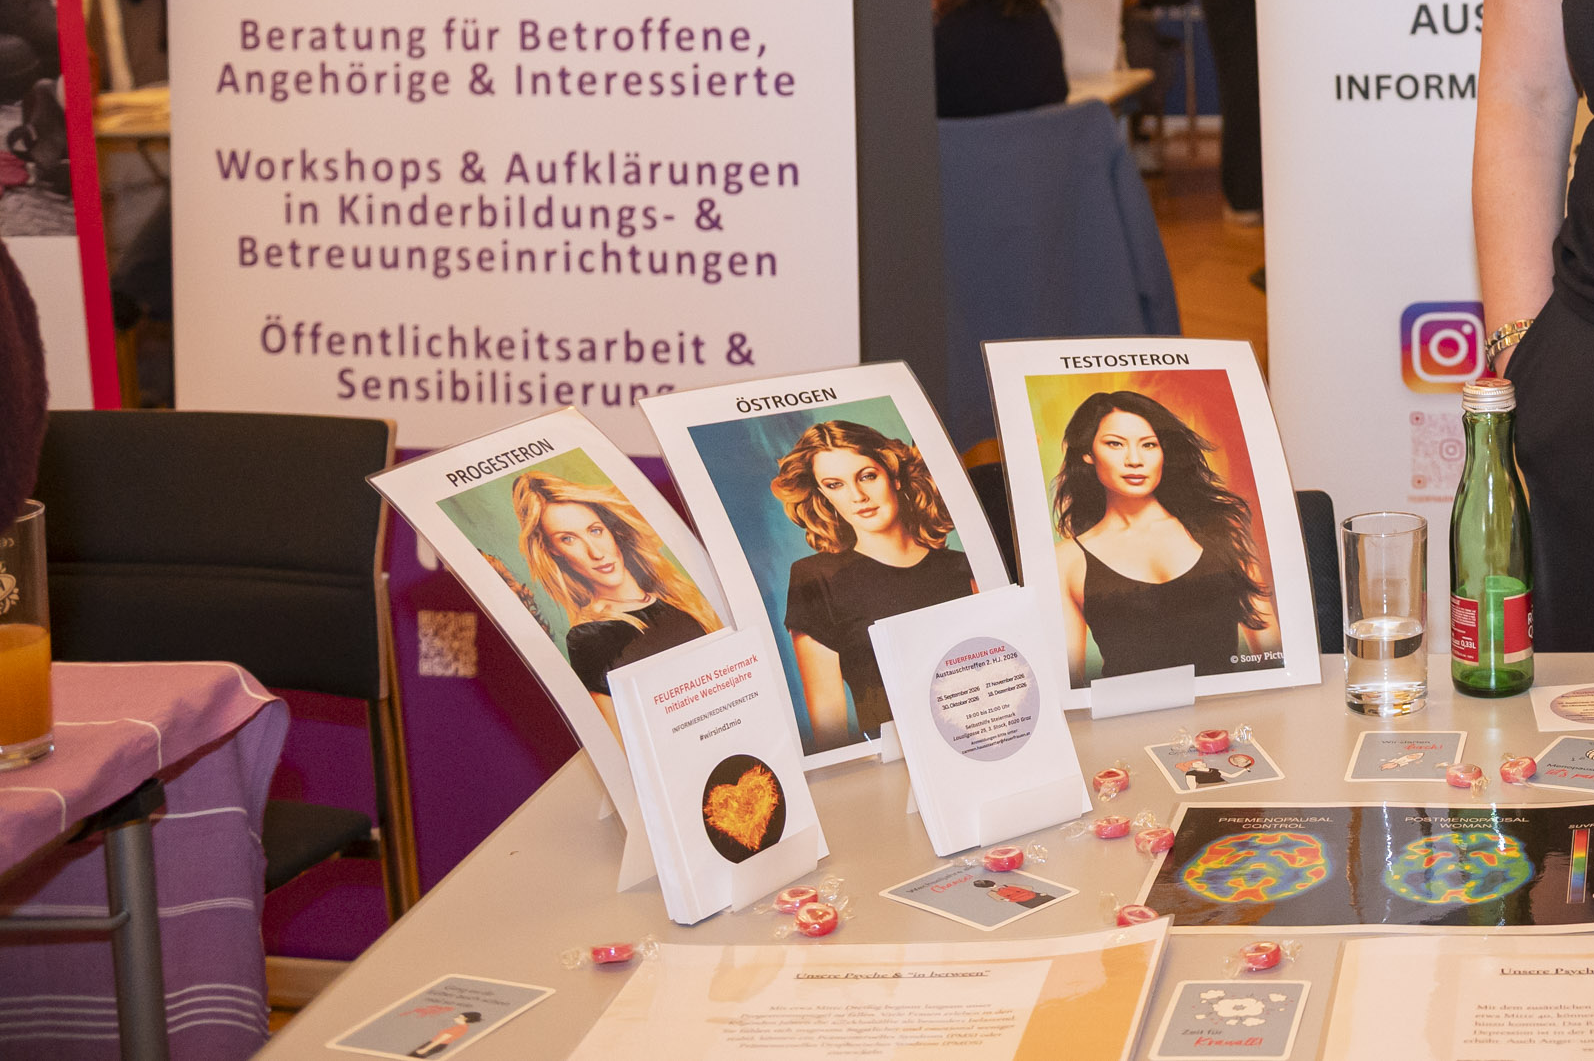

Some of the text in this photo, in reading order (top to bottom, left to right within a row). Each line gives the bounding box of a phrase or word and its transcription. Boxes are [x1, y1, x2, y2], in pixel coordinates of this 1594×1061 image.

[240, 18, 769, 59] Beratung für Betroffene,
[216, 61, 798, 104] Angehörige & Interessierte
[1334, 73, 1477, 101] INFORM
[216, 149, 802, 195] Workshops & Aufklärungen
[284, 193, 724, 238] in Kinderbildungs- &
[238, 237, 780, 284] Betreuungseinrichtungen
[261, 314, 756, 367] Öffentlichkeitsarbeit &
[1060, 353, 1190, 369] TESTOSTERON
[338, 368, 677, 409] Sensibilisierun
[735, 386, 838, 414] ÖSTROGEN
[445, 437, 555, 488] PROGESTERON
[935, 660, 986, 680] Austauschtreffen
[944, 645, 1006, 667] FEUERFRAUEN GRAZ
[1240, 651, 1285, 665] Sony Pictu
[653, 654, 759, 706] FEUERFRAUEN Steiermark
[664, 671, 753, 715] Initiative Wechseljahre
[1404, 816, 1531, 824] POSTMENOPAUSAL
[795, 972, 842, 980] Unsere
[844, 972, 890, 980] Psyche
[1499, 968, 1551, 976] Unsere
